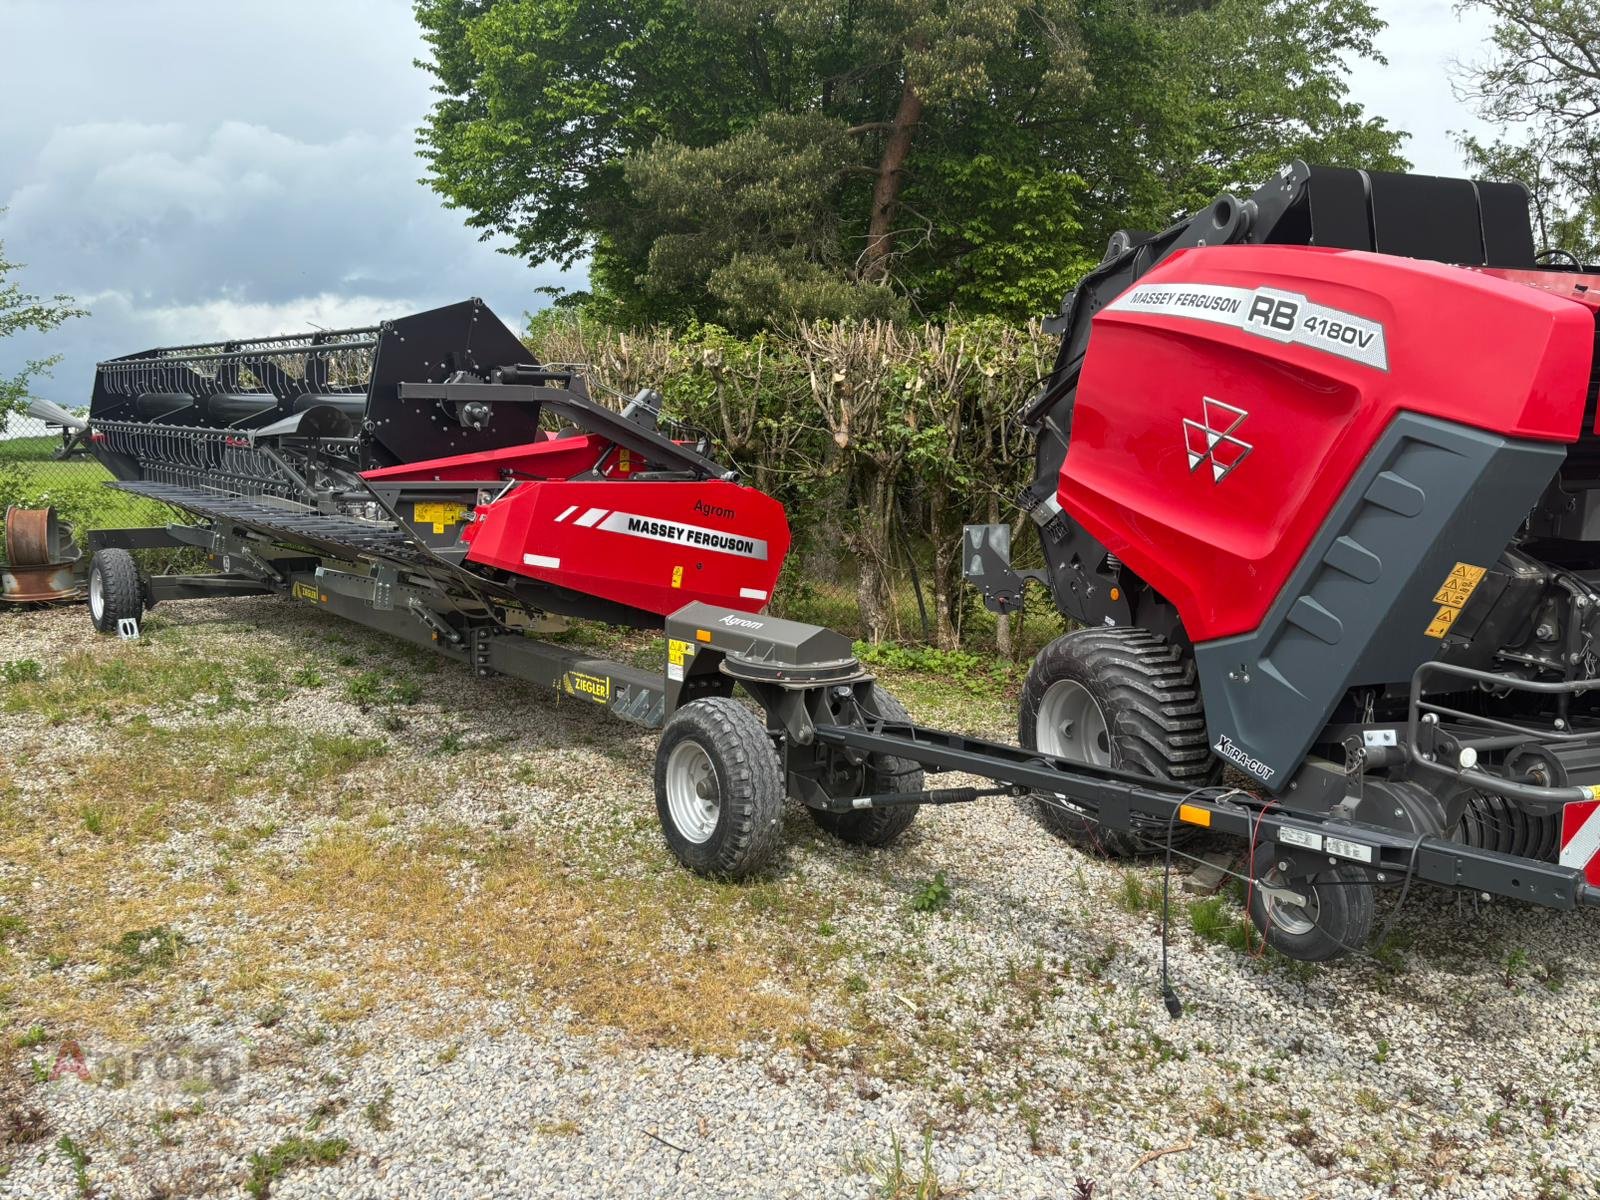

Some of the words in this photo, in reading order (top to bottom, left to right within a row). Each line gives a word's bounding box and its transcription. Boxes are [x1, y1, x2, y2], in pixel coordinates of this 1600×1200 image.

[1130, 292, 1176, 306] MASSEY
[1175, 293, 1242, 314] FERGUSON
[1247, 295, 1299, 332] RB
[1303, 316, 1375, 348] 4180V
[693, 498, 736, 520] Agrom
[627, 517, 685, 541] MASSEY
[686, 529, 754, 554] FERGUSON
[719, 614, 764, 630] Agrom
[575, 677, 606, 698] ZIEGLER
[1213, 734, 1275, 780] XTRA-CUT
